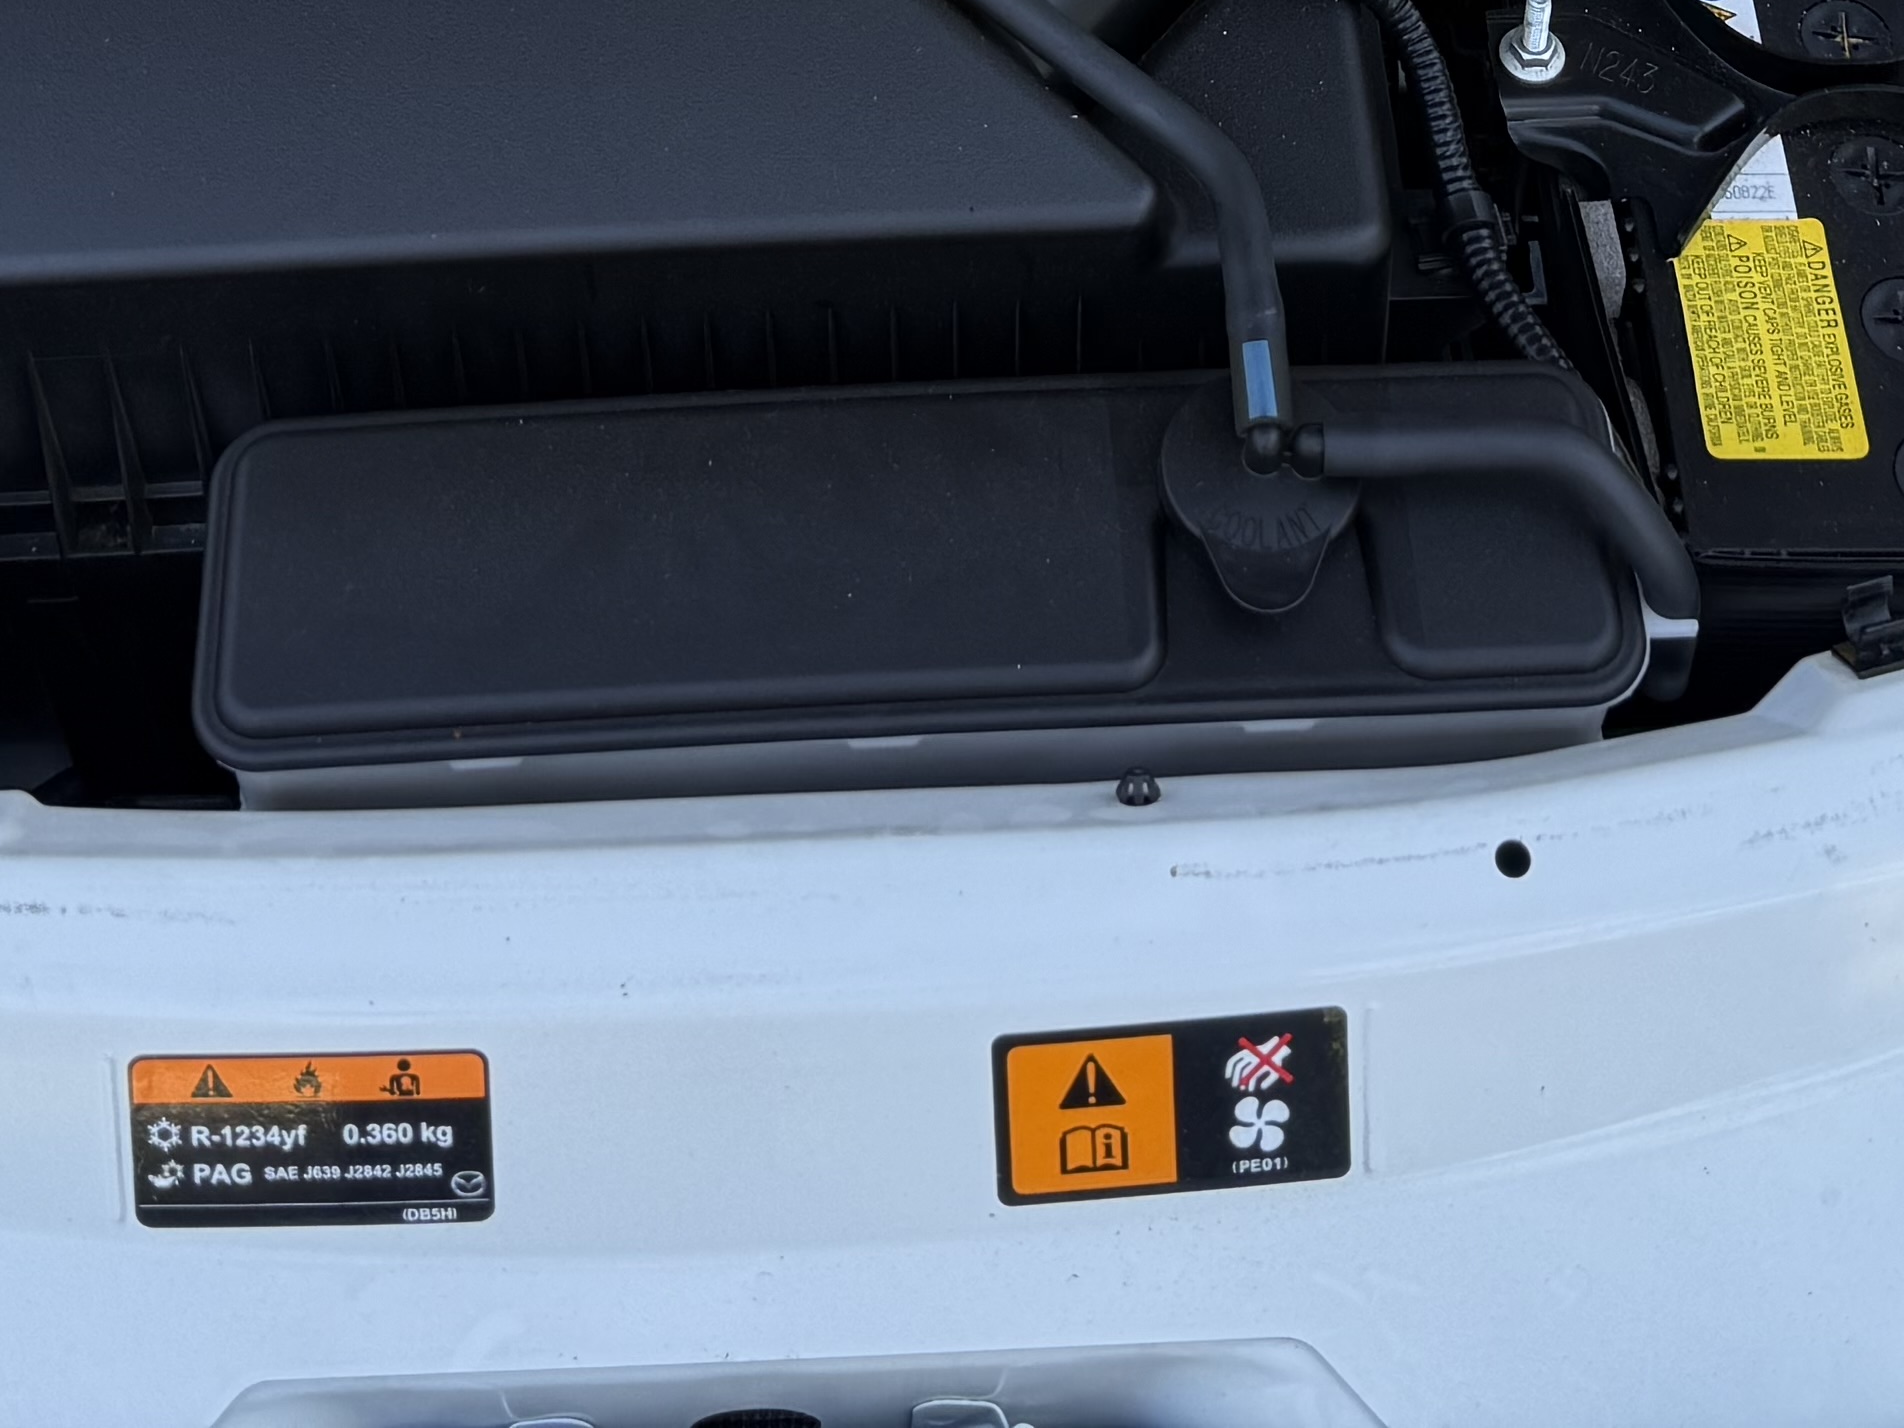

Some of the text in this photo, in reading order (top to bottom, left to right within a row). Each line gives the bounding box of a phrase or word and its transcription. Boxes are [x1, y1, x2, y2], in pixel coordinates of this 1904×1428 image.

[1688, 254, 1707, 279] KEEP
[1730, 254, 1760, 311] POISON
[1693, 281, 1712, 301] OUT
[1697, 303, 1715, 317] OF
[1701, 319, 1721, 354] REACH
[1741, 314, 1764, 356] CAUSES
[1750, 251, 1798, 427] KEEP VENT CAPS TIGHT AND LEVEL
[1806, 260, 1855, 429] DANGER EXPLOSIVE GASES
[1708, 357, 1725, 371] OF
[1750, 358, 1772, 400] SEVERE
[1711, 372, 1735, 424] CHILDREN
[1758, 402, 1780, 440] BURNS
[191, 1121, 454, 1152] R-1234yf 0.360 kg
[194, 1162, 443, 1186] PAG SAE J639 J2842 J2845
[1232, 1156, 1289, 1174] (PE01)
[402, 1207, 458, 1222] (DB5H)
